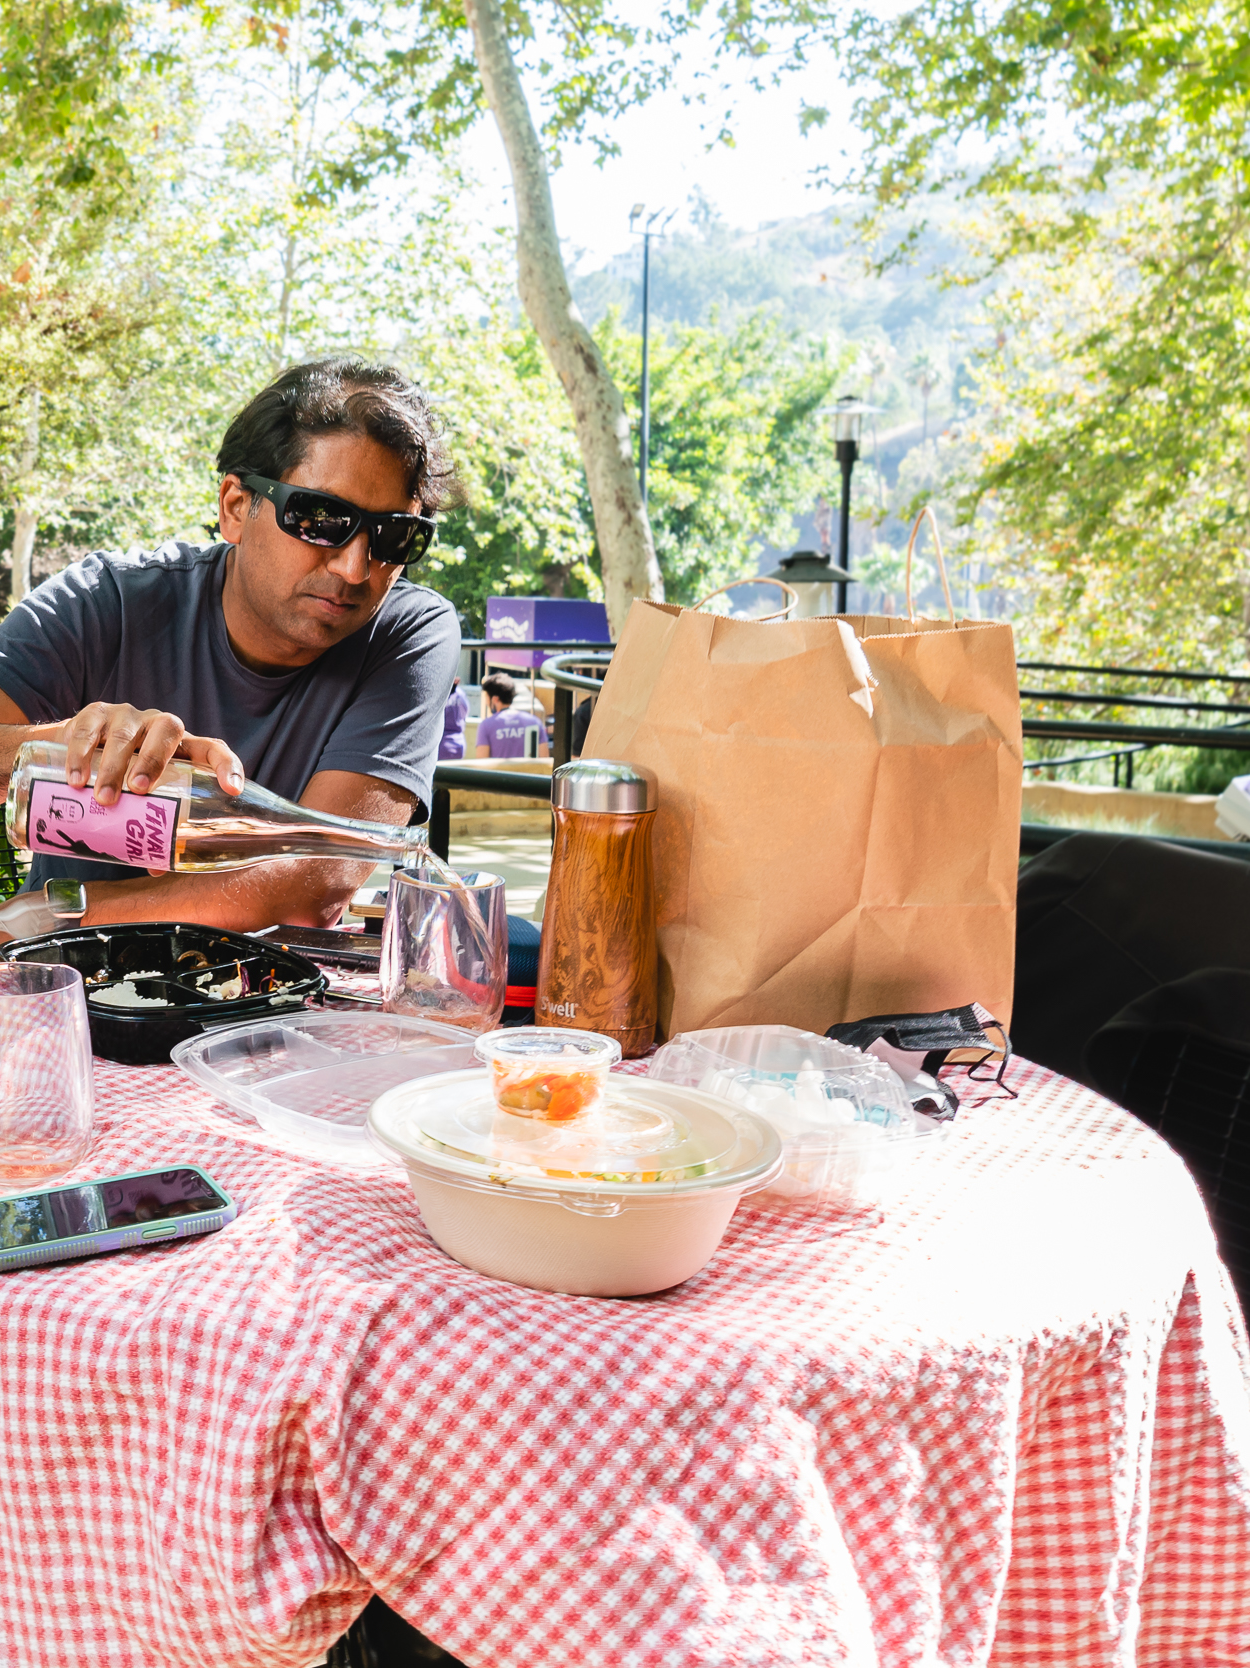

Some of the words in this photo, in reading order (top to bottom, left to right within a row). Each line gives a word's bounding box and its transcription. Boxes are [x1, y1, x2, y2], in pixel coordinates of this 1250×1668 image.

[496, 727, 525, 740] STAF
[125, 819, 146, 862] GIRL
[145, 801, 167, 861] FINAL
